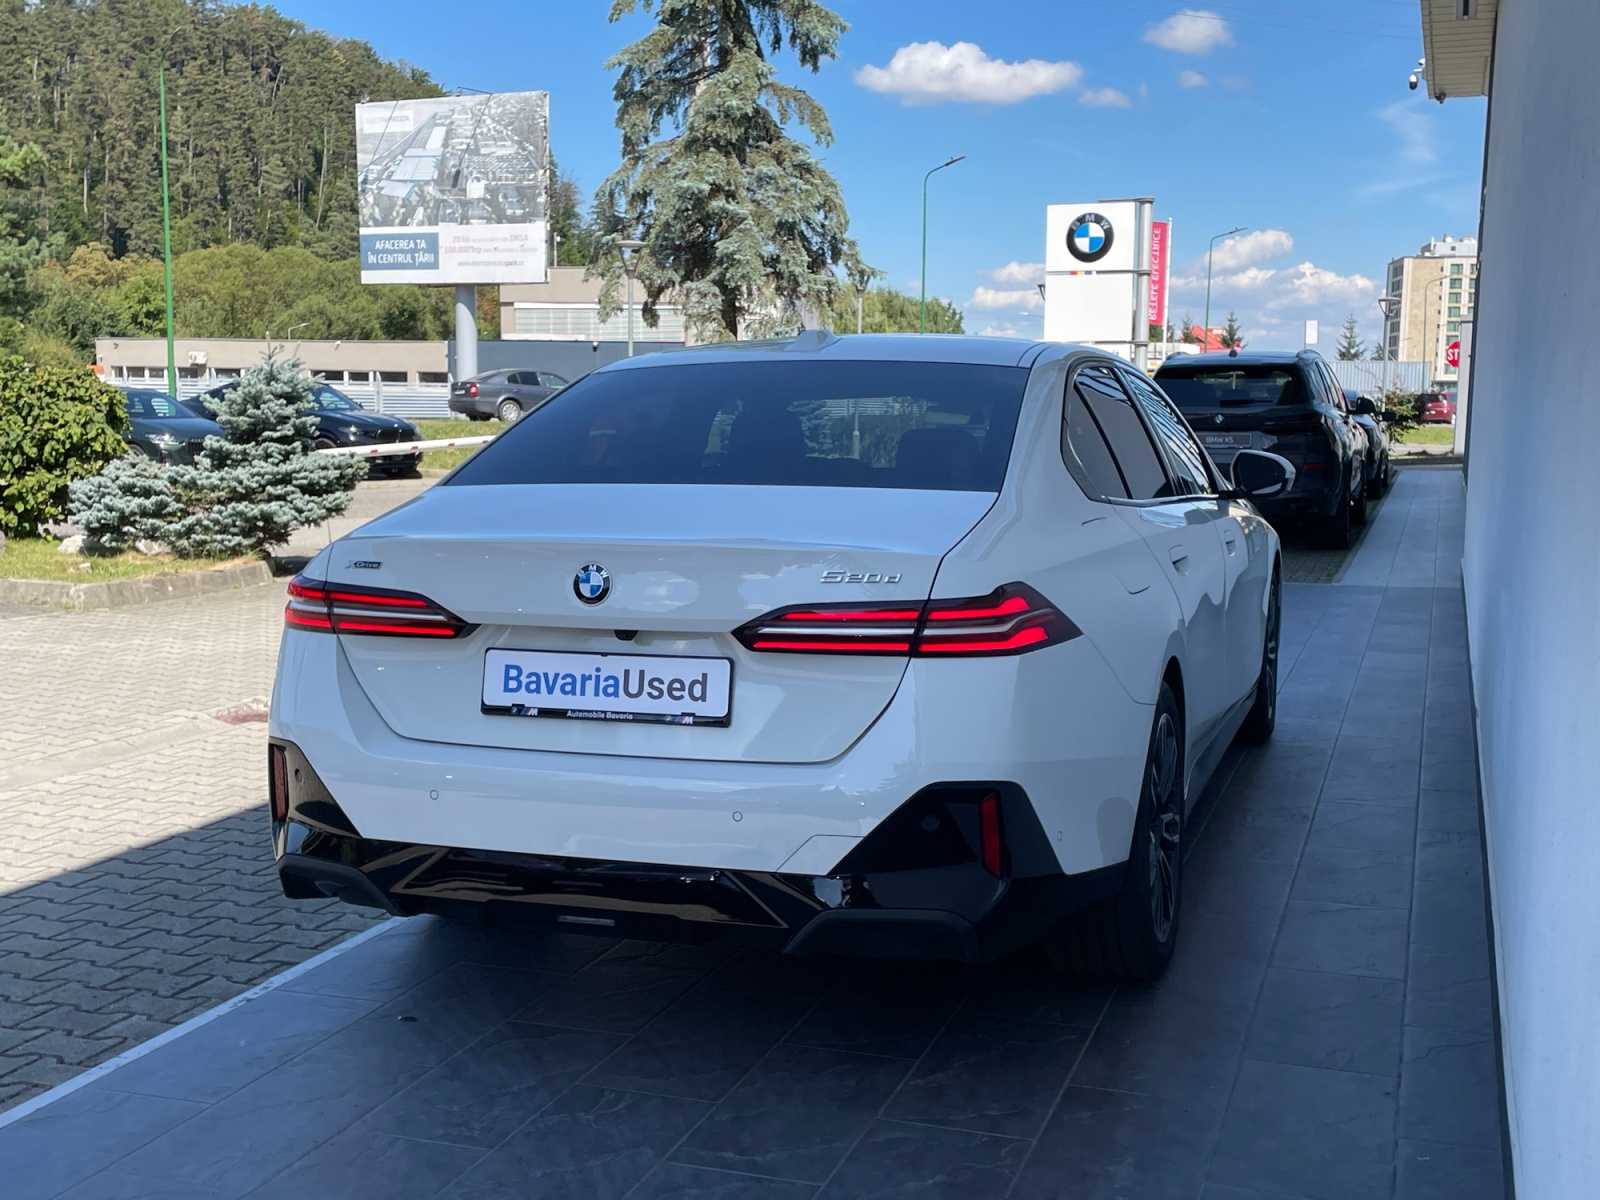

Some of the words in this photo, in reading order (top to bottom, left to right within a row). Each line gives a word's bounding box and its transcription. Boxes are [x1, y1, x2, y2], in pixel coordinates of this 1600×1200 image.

[374, 239, 415, 250] AFACEREA
[416, 239, 427, 249] TA
[367, 251, 377, 264] ÎN
[378, 253, 413, 264] CENTRUL
[1447, 349, 1459, 361] ST
[1206, 436, 1223, 444] BMW
[820, 570, 902, 584] 520d
[503, 664, 708, 702] BavariaUsed
[566, 710, 605, 719] Automobile
[606, 711, 633, 720] Bavaria
